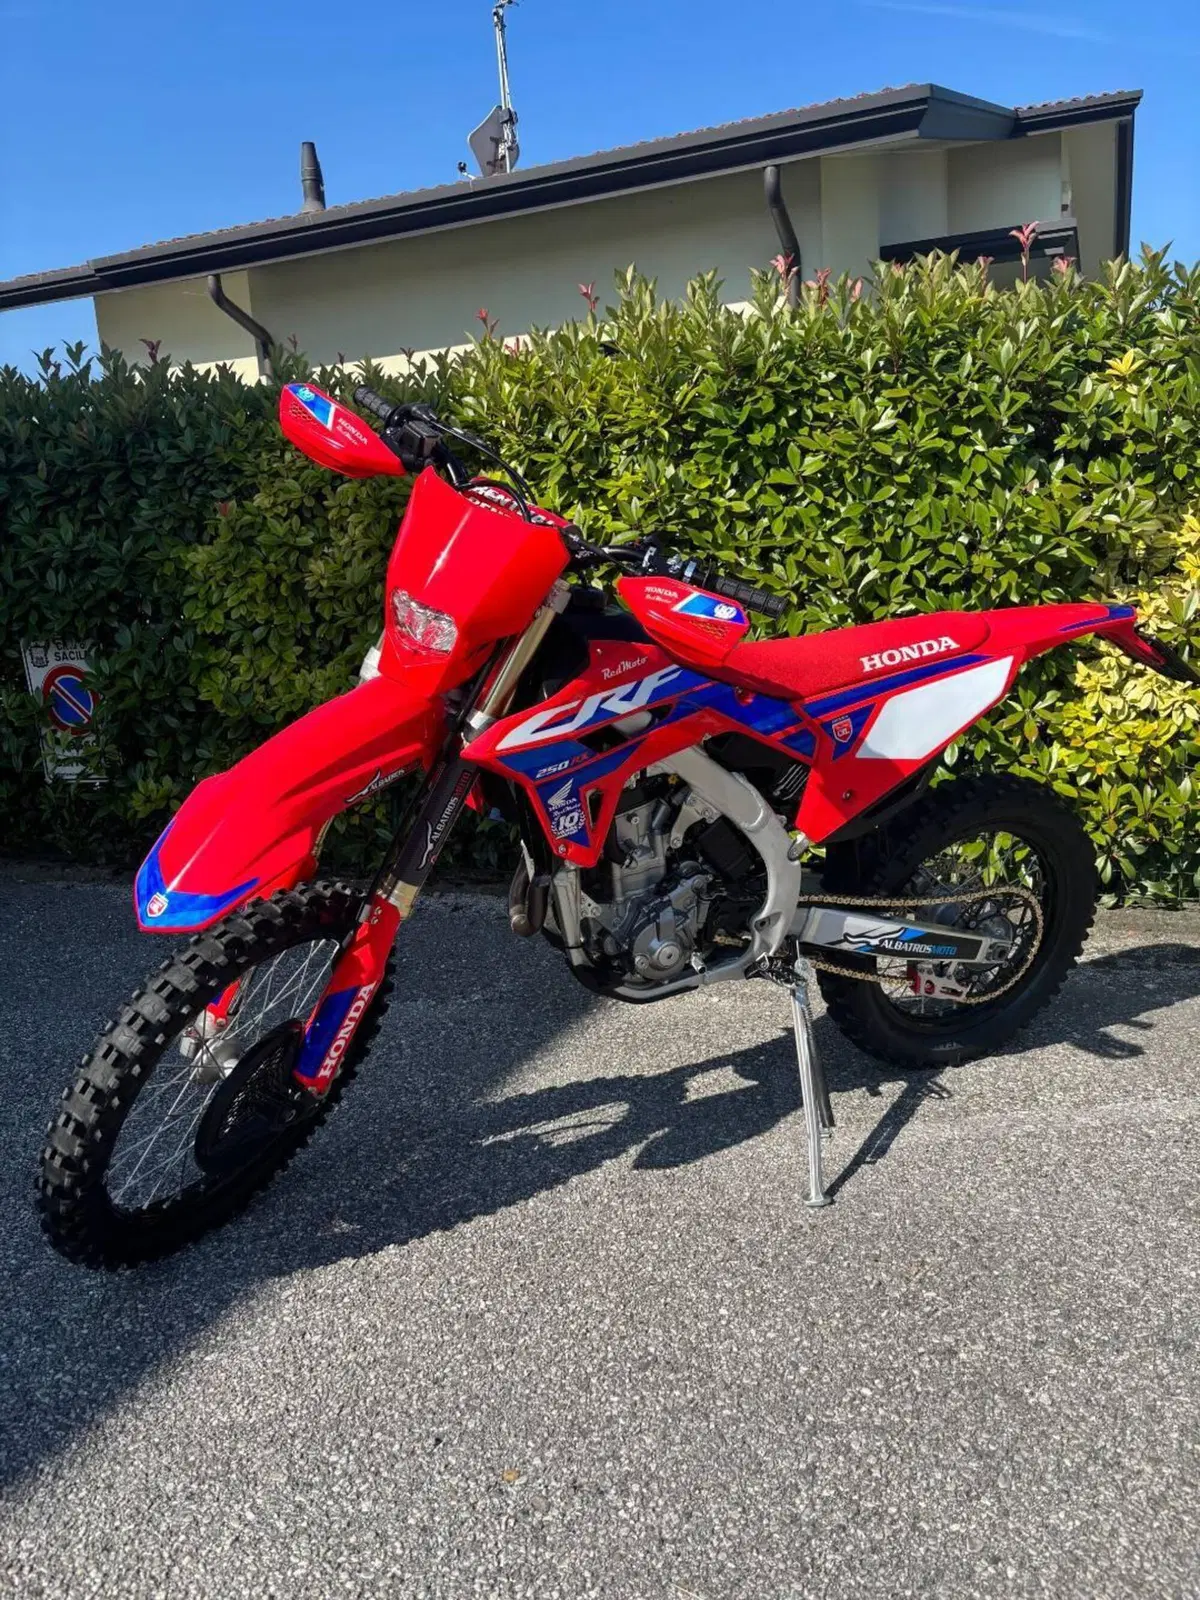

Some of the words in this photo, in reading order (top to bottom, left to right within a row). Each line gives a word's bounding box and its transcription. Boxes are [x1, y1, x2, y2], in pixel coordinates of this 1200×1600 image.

[338, 418, 368, 445] HONDA
[644, 586, 678, 599] HONDA
[54, 650, 88, 661] SACIL
[860, 636, 960, 672] HONDA
[495, 664, 683, 750] CRF
[548, 798, 577, 812] HONDA
[558, 811, 580, 831] 10
[318, 980, 378, 1078] HONDA
